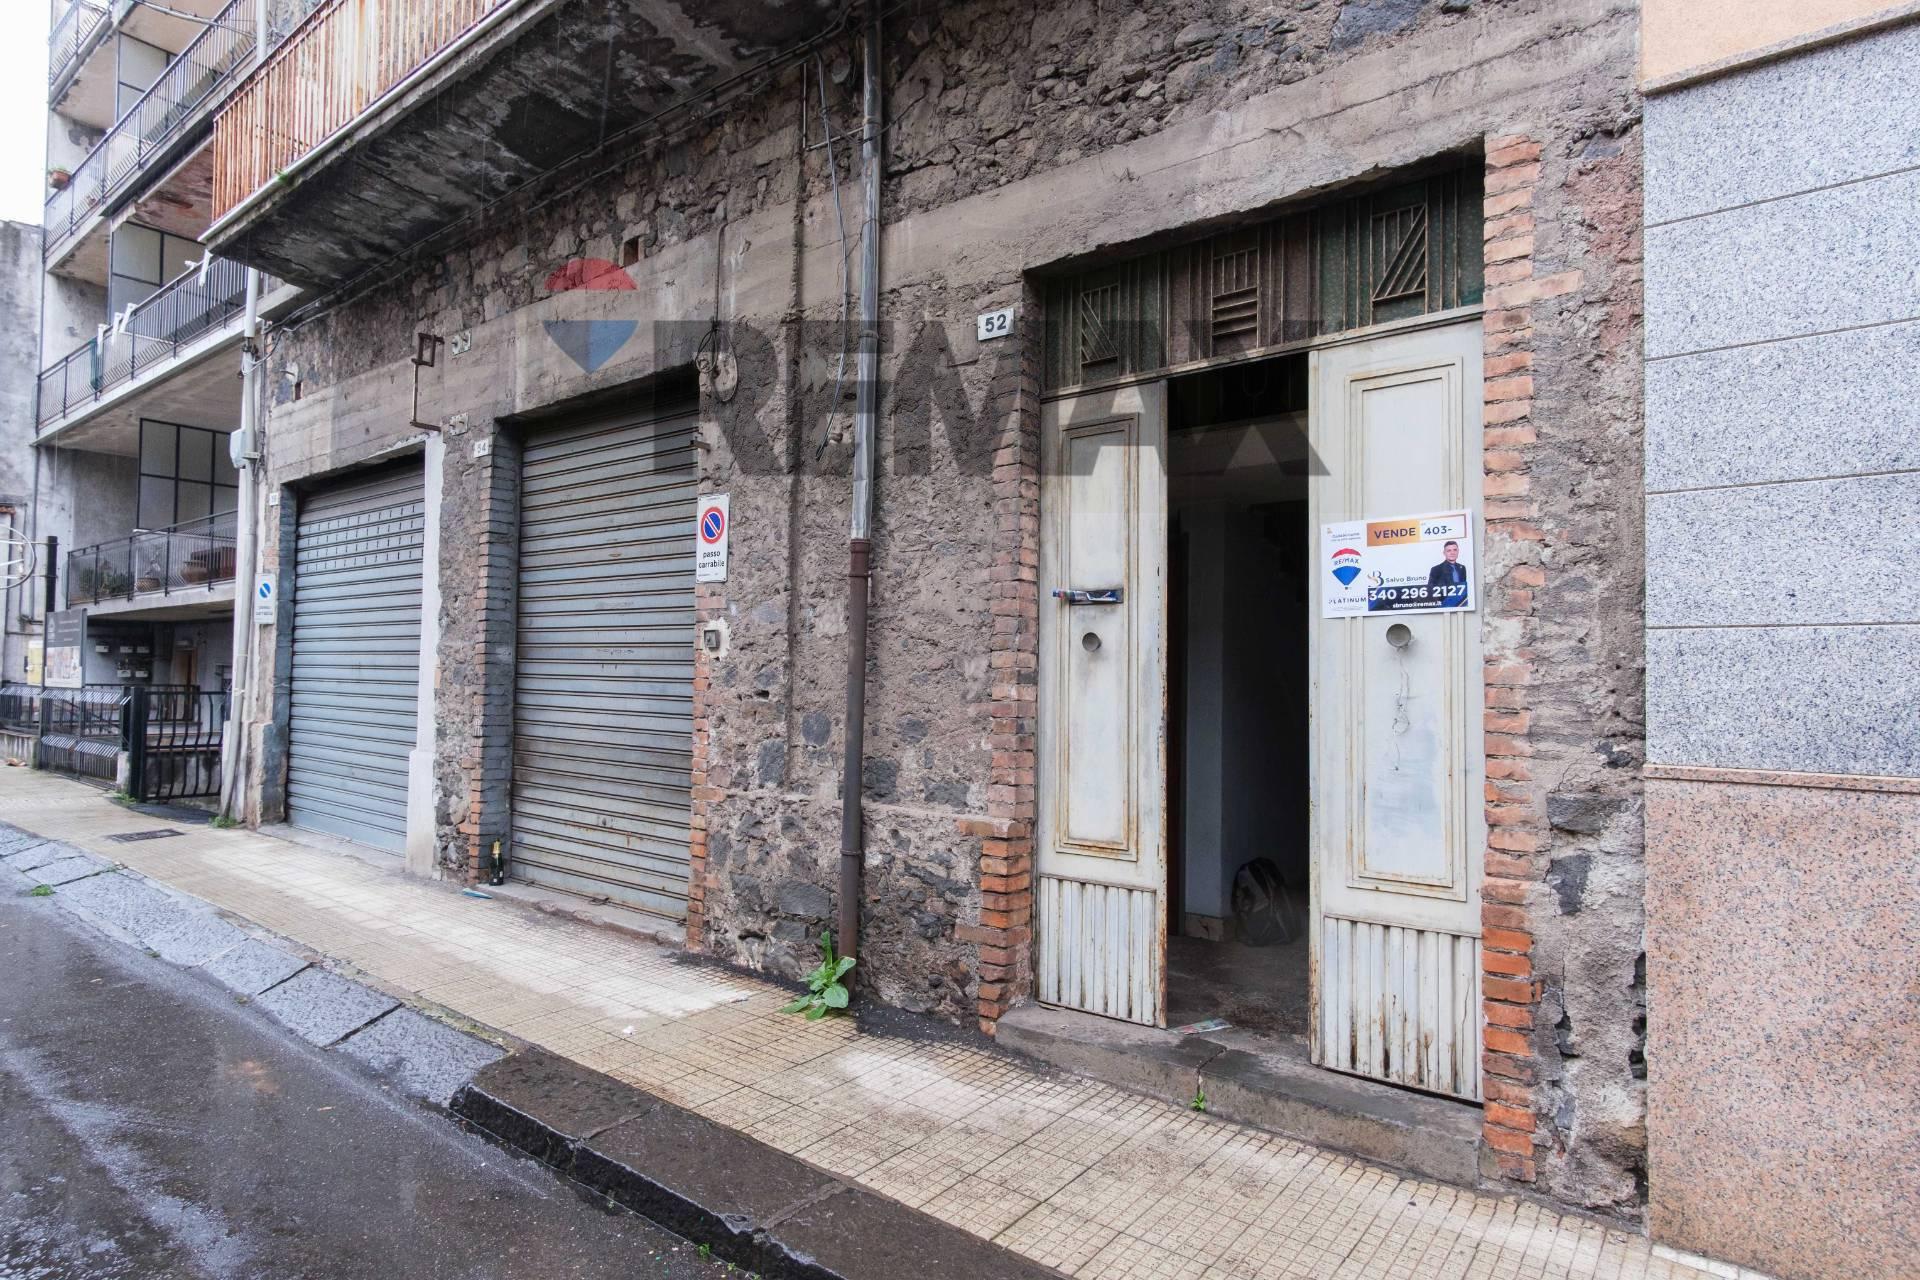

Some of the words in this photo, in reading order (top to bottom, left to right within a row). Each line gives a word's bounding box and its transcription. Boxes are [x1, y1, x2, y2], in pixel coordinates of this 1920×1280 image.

[985, 313, 1007, 332] 52
[1374, 527, 1416, 539] VENDE
[702, 551, 721, 559] passo
[698, 559, 725, 569] carrabile
[1333, 558, 1360, 566] RE/MAX
[1369, 589, 1397, 601] 340
[1401, 587, 1428, 600] 296
[1432, 585, 1466, 598] 2127
[1328, 597, 1367, 605] PLATINUM
